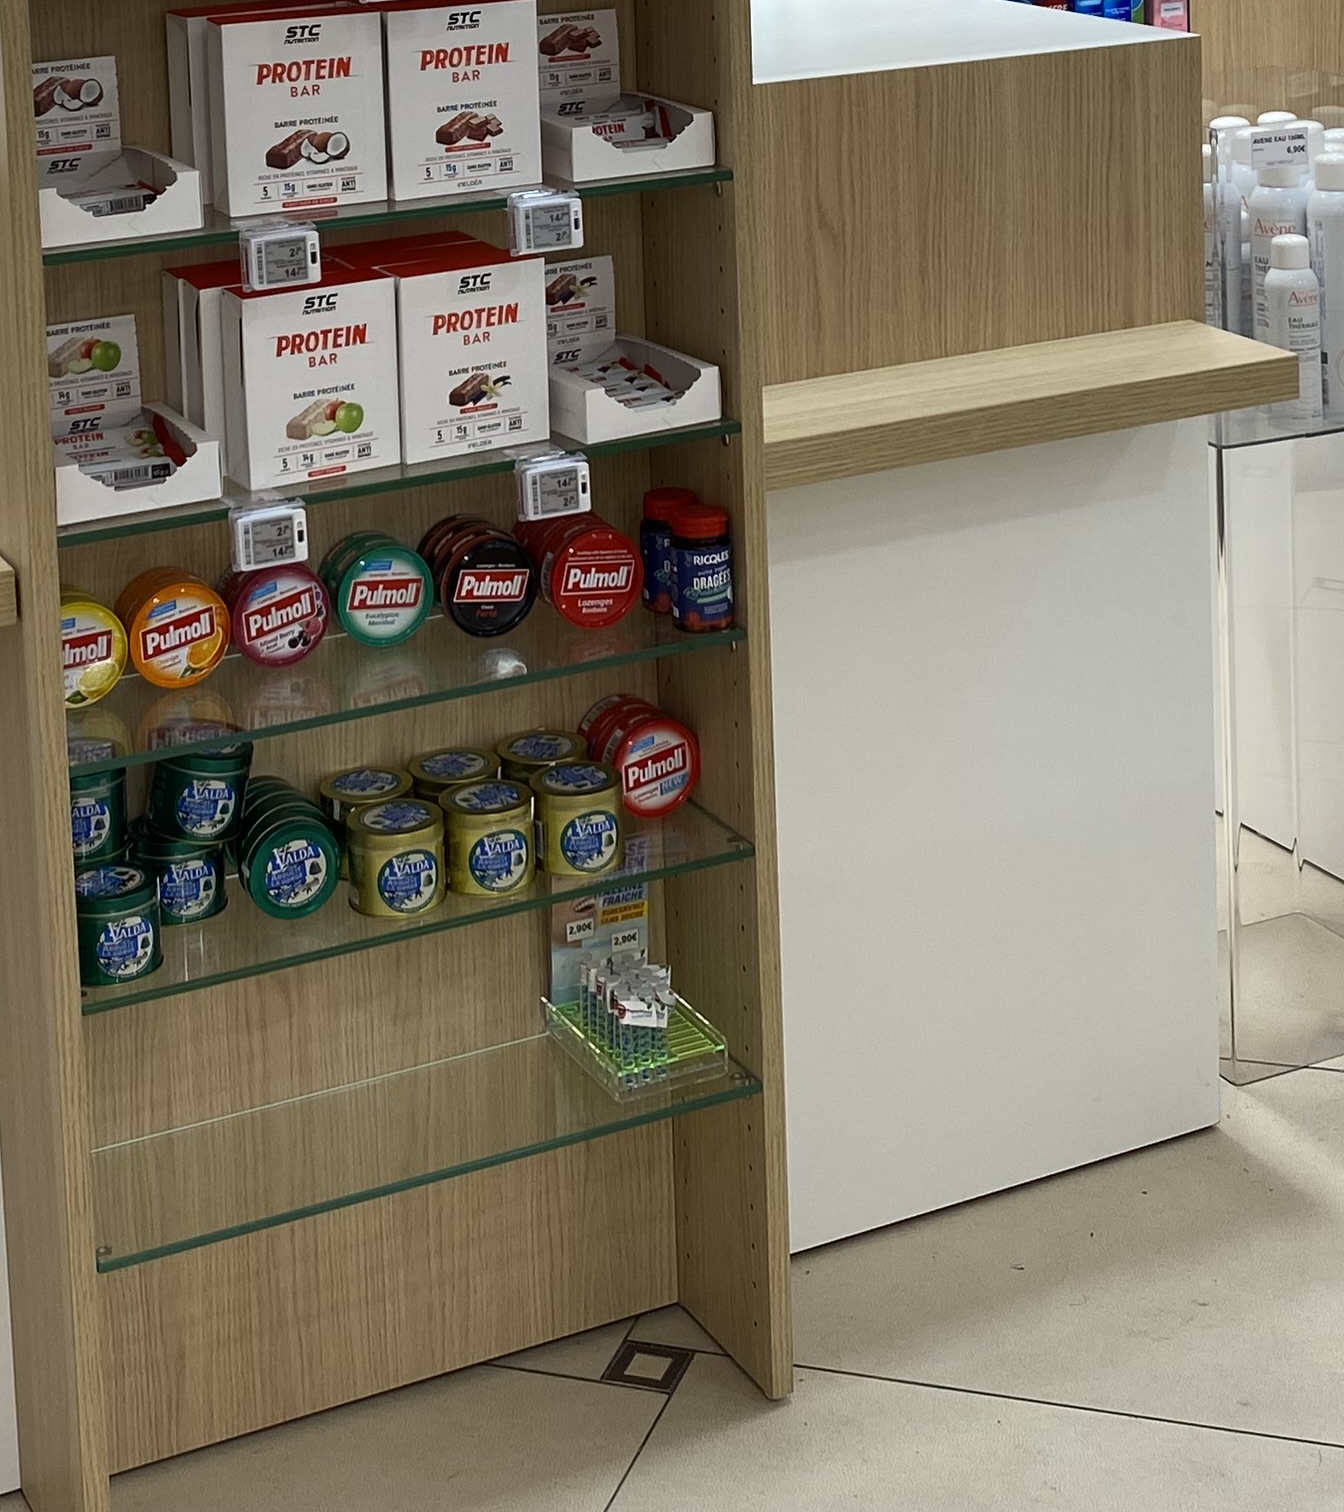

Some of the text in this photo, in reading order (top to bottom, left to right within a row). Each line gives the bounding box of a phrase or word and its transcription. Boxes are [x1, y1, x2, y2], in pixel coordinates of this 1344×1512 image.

[1253, 136, 1271, 145] AVENE
[1273, 135, 1286, 143] EAU
[1287, 144, 1306, 154] 6,90€
[1255, 222, 1296, 235] Avène
[304, 294, 338, 309] STC
[432, 302, 519, 336] PROTEIN
[276, 324, 368, 358] PROTEIN
[464, 331, 491, 346] BAR
[308, 353, 338, 368] BAR
[293, 383, 355, 400] BARRE PROTÉINÉE
[461, 576, 521, 596] Pulmoll
[693, 570, 730, 590] DRAGÉES
[354, 583, 417, 606] Pulmoll
[578, 598, 613, 608] Lozenges
[568, 921, 593, 936] 2,90€
